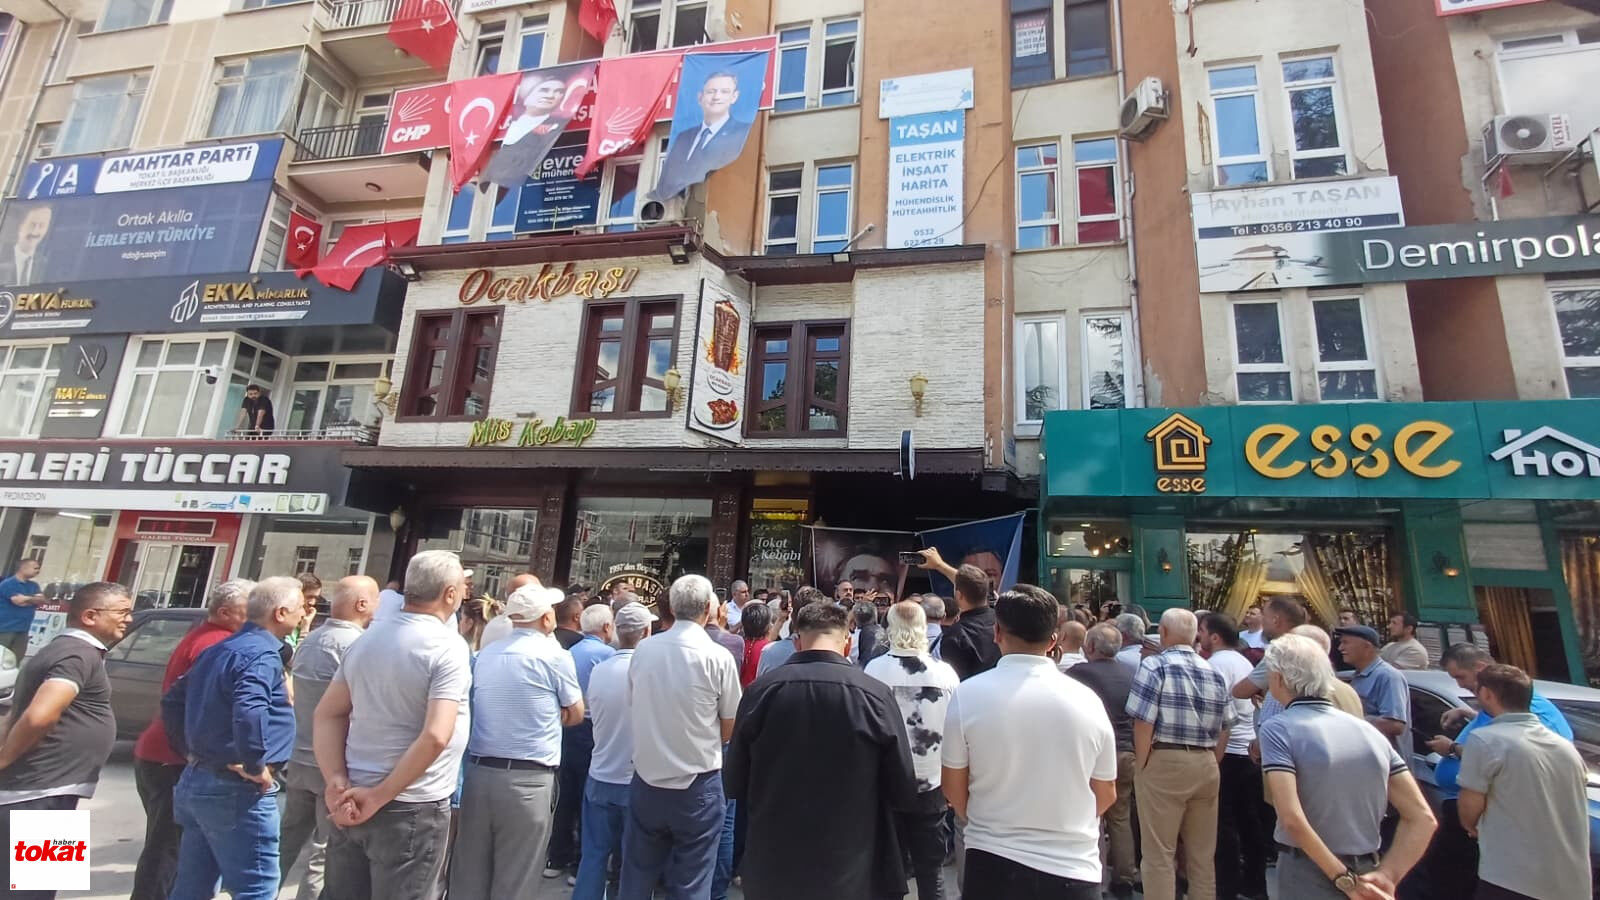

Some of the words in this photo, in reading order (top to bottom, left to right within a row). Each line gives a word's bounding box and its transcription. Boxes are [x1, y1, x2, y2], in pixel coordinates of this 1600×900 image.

[392, 124, 431, 143] CHP
[896, 119, 957, 139] TAŞAN
[107, 152, 195, 175] ANAHTAR
[895, 148, 956, 163] ELEKTRİK
[59, 164, 78, 187] A
[902, 164, 948, 178] İNŞAAT
[901, 177, 948, 191] HARİTA
[895, 195, 955, 206] MÜHENDİSLİK
[117, 212, 154, 227] Ortak
[157, 209, 193, 224] Akılla
[1231, 226, 1249, 236] Tel
[1261, 223, 1293, 233] 0356
[1296, 221, 1321, 231] 213
[1325, 219, 1341, 228] 40
[1345, 217, 1362, 227] 90
[85, 232, 155, 248] İLERLEYEN
[157, 224, 216, 243] TÜRKİYE
[202, 282, 255, 302] EKVA
[256, 288, 309, 300] MİMARLIK
[459, 262, 639, 305] Ocakbaşı
[15, 293, 62, 310] EKVA
[467, 416, 512, 448] Mis
[517, 416, 596, 448] Kebap
[1244, 420, 1462, 480] esse
[121, 447, 291, 485] TÜCCAR
[1157, 477, 1206, 492] esse
[757, 537, 788, 548] Tokat
[762, 549, 801, 561] Kebabı
